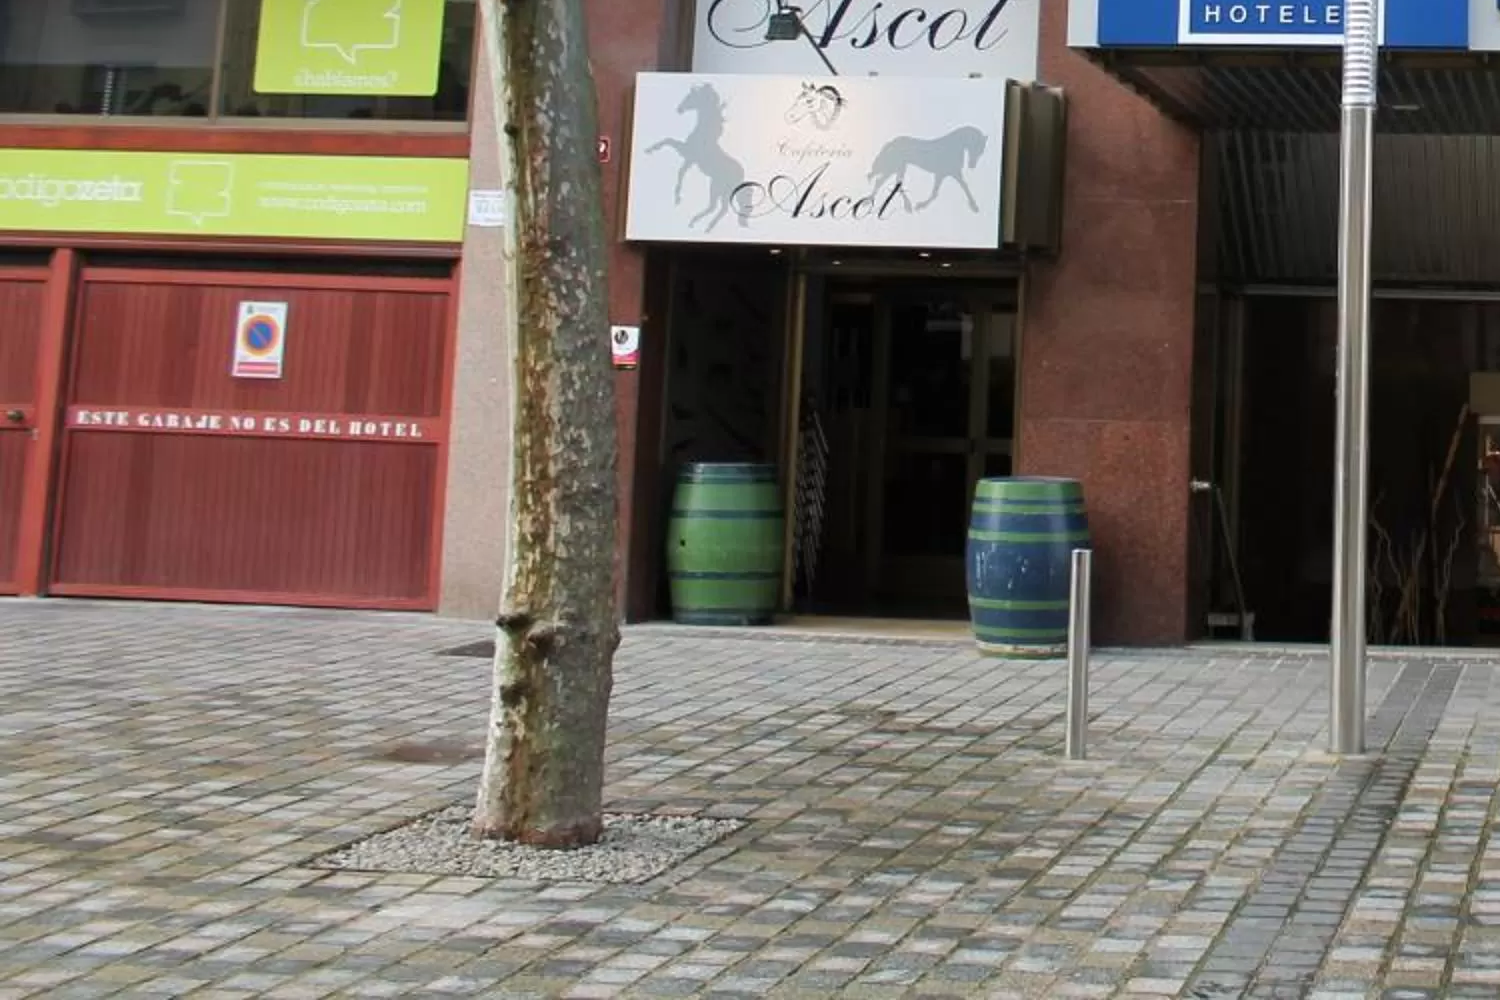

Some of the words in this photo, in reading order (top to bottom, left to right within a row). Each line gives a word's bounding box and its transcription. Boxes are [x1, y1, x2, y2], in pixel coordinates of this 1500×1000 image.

[1204, 4, 1342, 24] HOTELE
[729, 161, 912, 219] Ascot
[77, 410, 129, 426] ESTE
[138, 413, 222, 431] GARAJE
[231, 416, 255, 431] NO
[264, 417, 291, 432] ES
[300, 418, 341, 435] DEL
[349, 421, 422, 438] HOTEL
